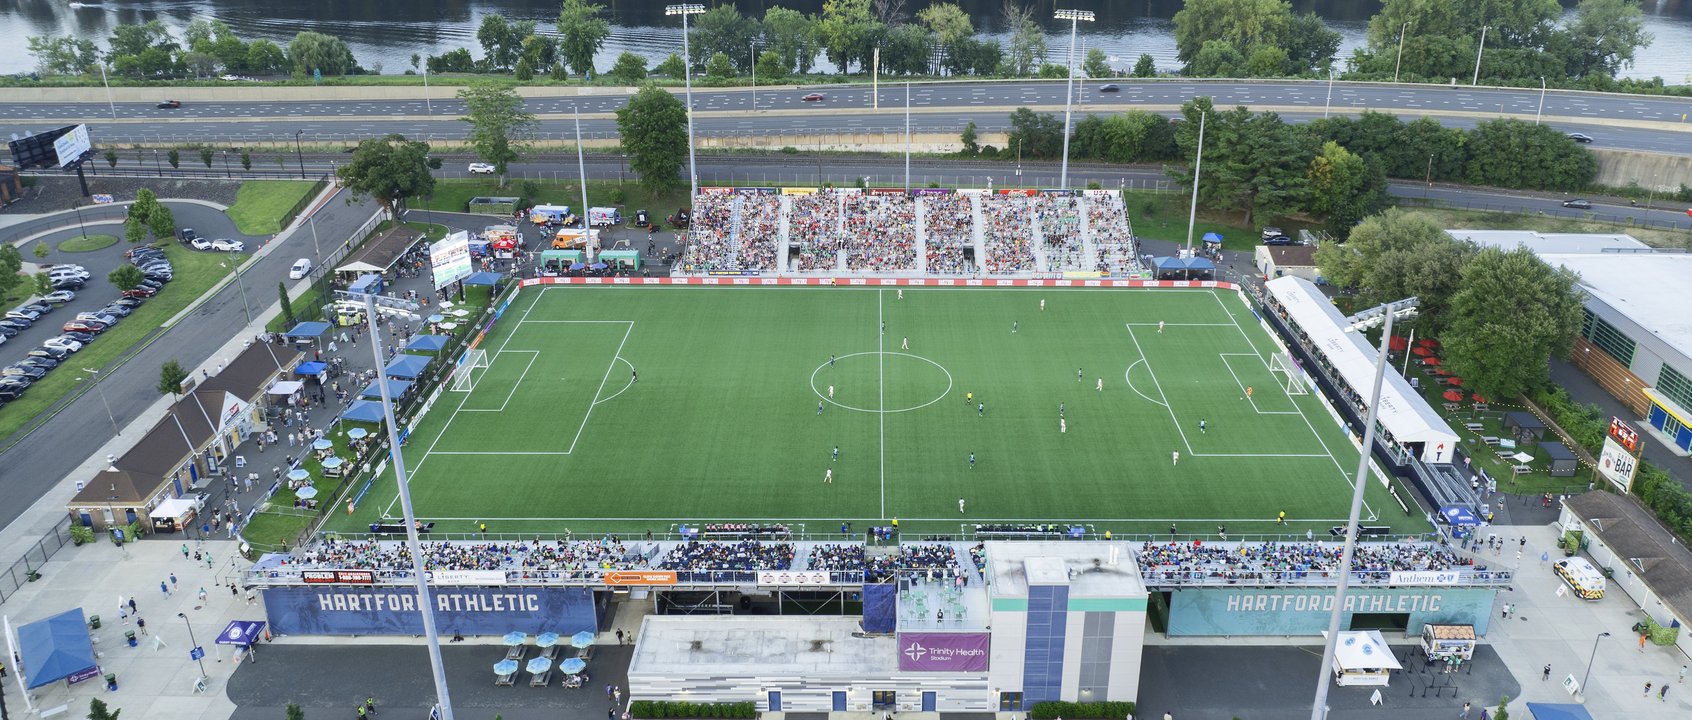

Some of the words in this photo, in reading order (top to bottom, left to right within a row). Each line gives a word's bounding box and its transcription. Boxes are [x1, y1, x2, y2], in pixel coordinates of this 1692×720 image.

[1614, 458, 1633, 478] BAR
[1396, 574, 1434, 583] Anthem
[437, 594, 539, 611] ATHLETIC
[1226, 595, 1336, 611] HARTFORD
[1343, 595, 1442, 611] ATHLETIC
[929, 647, 955, 656] Trinity
[955, 648, 984, 656] Health
